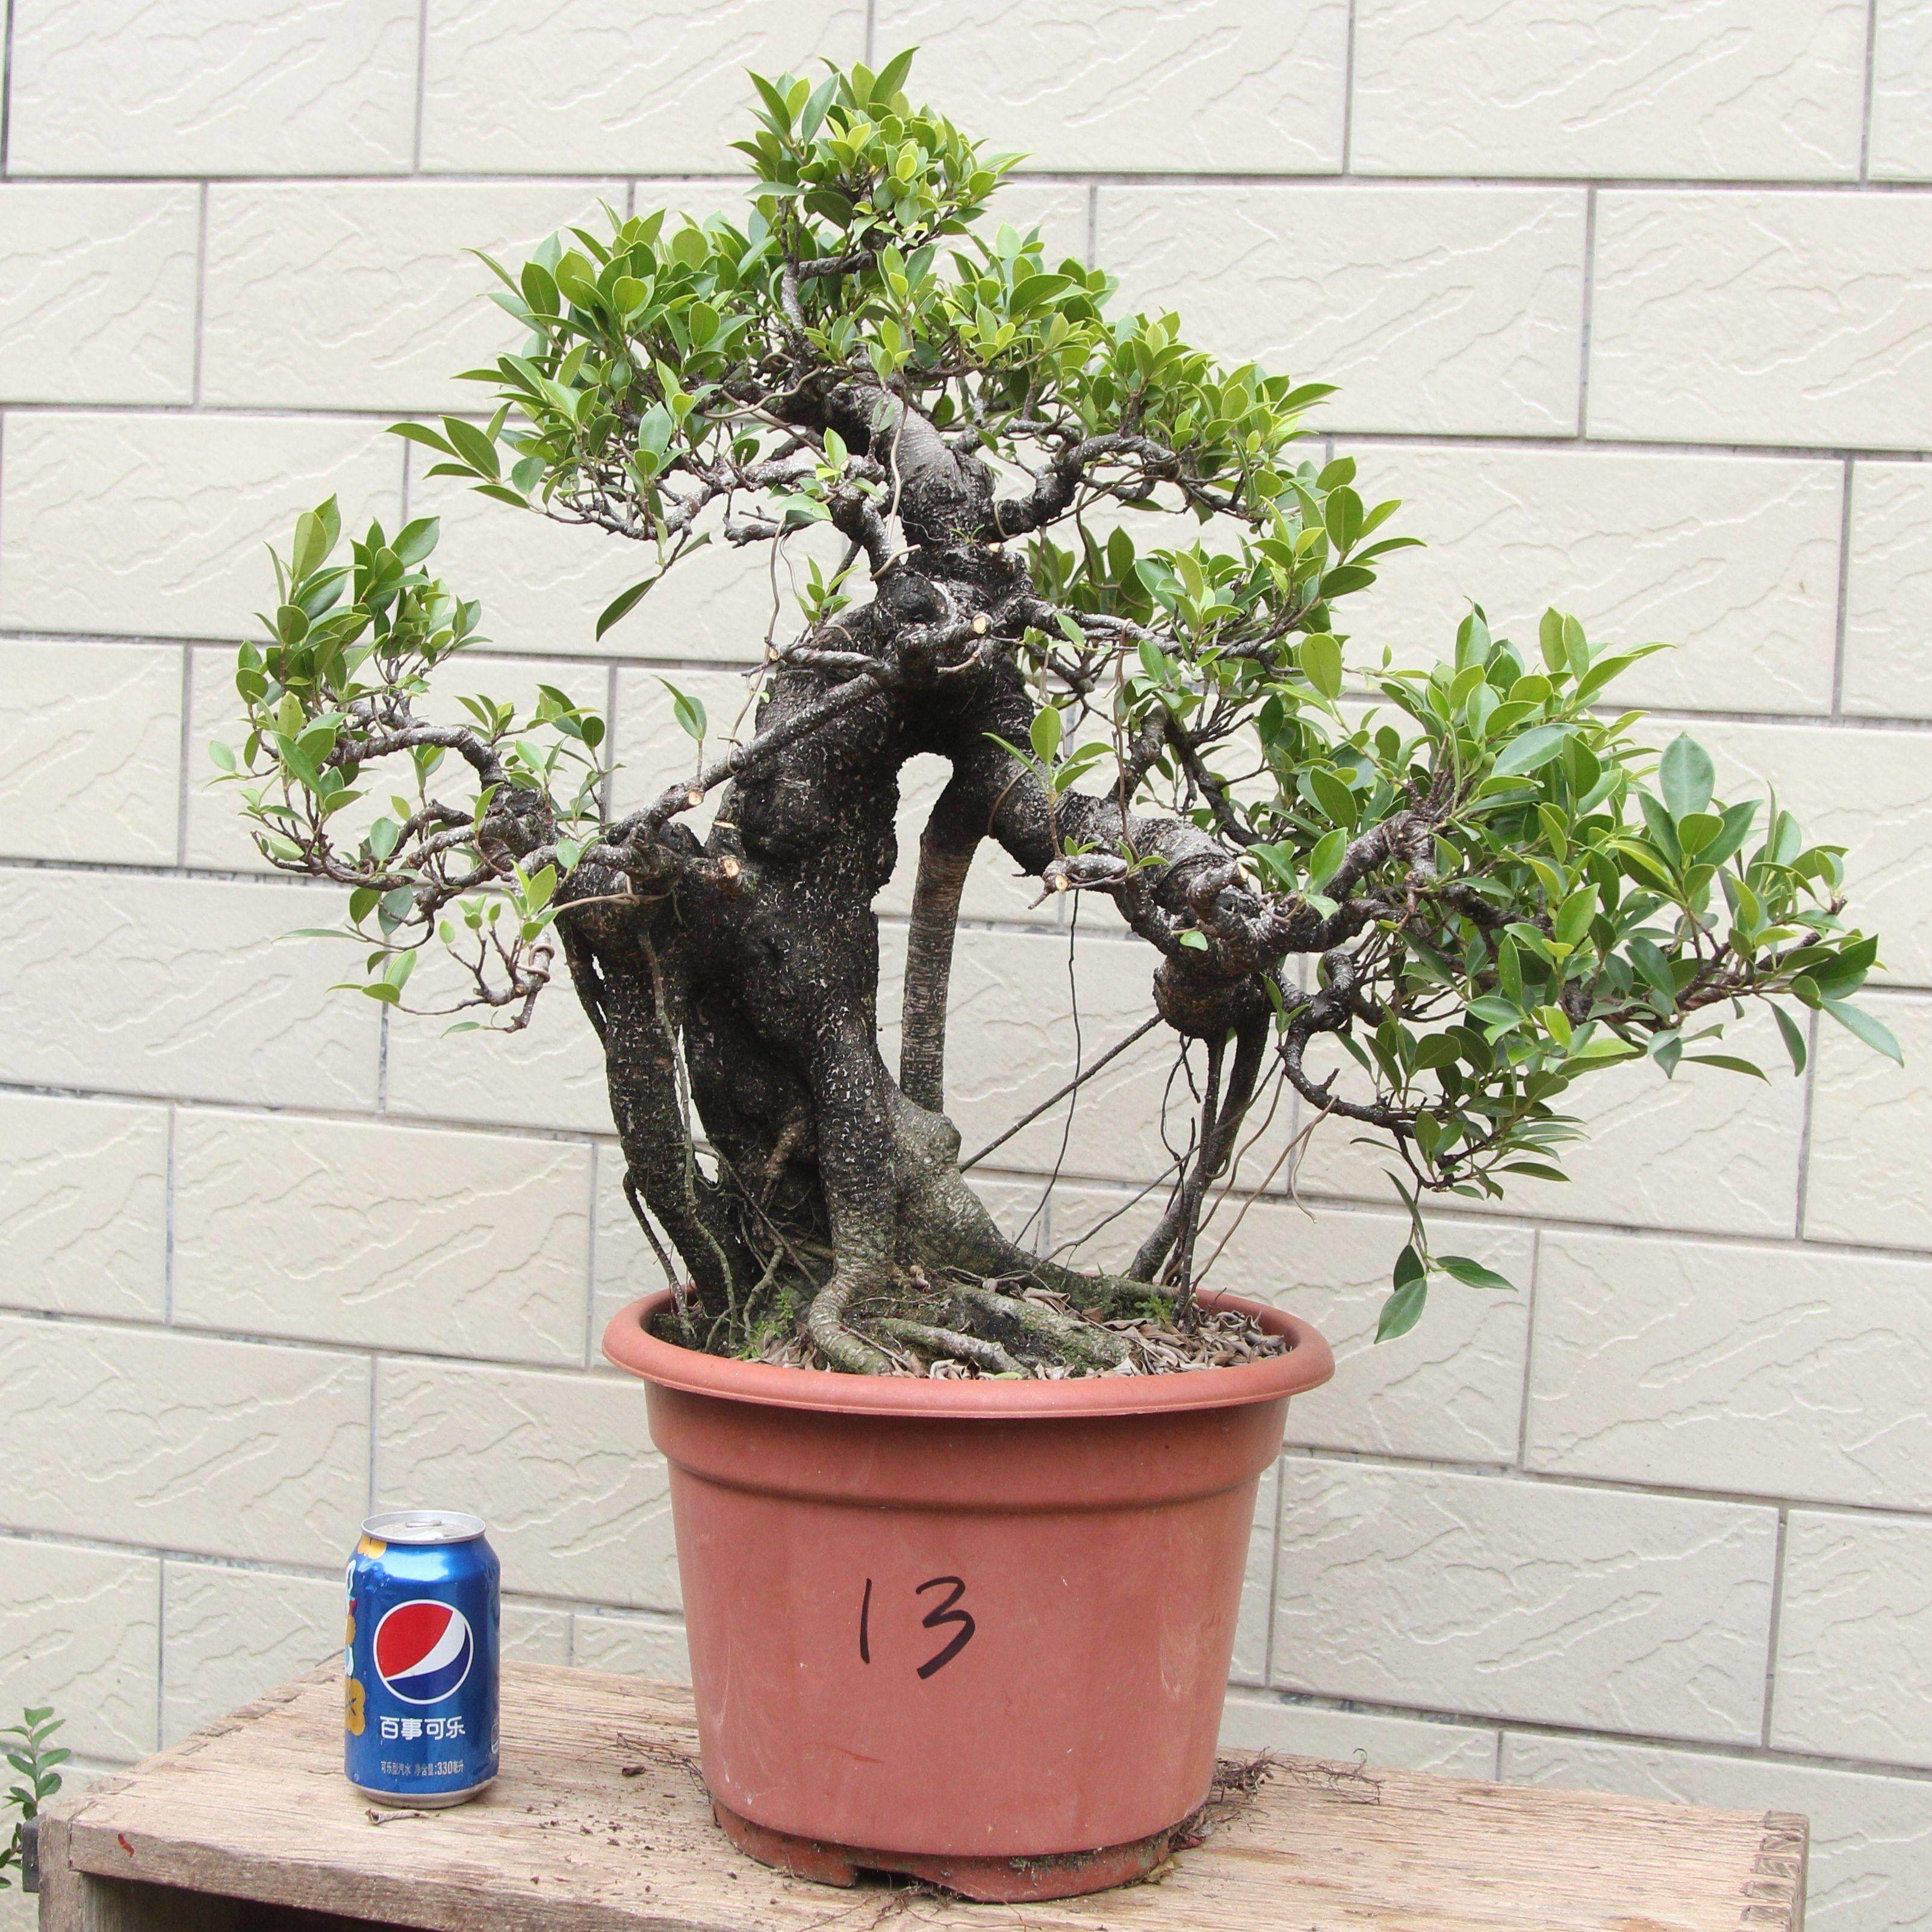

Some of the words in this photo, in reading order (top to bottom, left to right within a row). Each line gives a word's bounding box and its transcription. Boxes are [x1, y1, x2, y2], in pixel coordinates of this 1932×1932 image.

[860, 1576, 975, 1679] 13
[380, 1716, 465, 1740] 百事可乐
